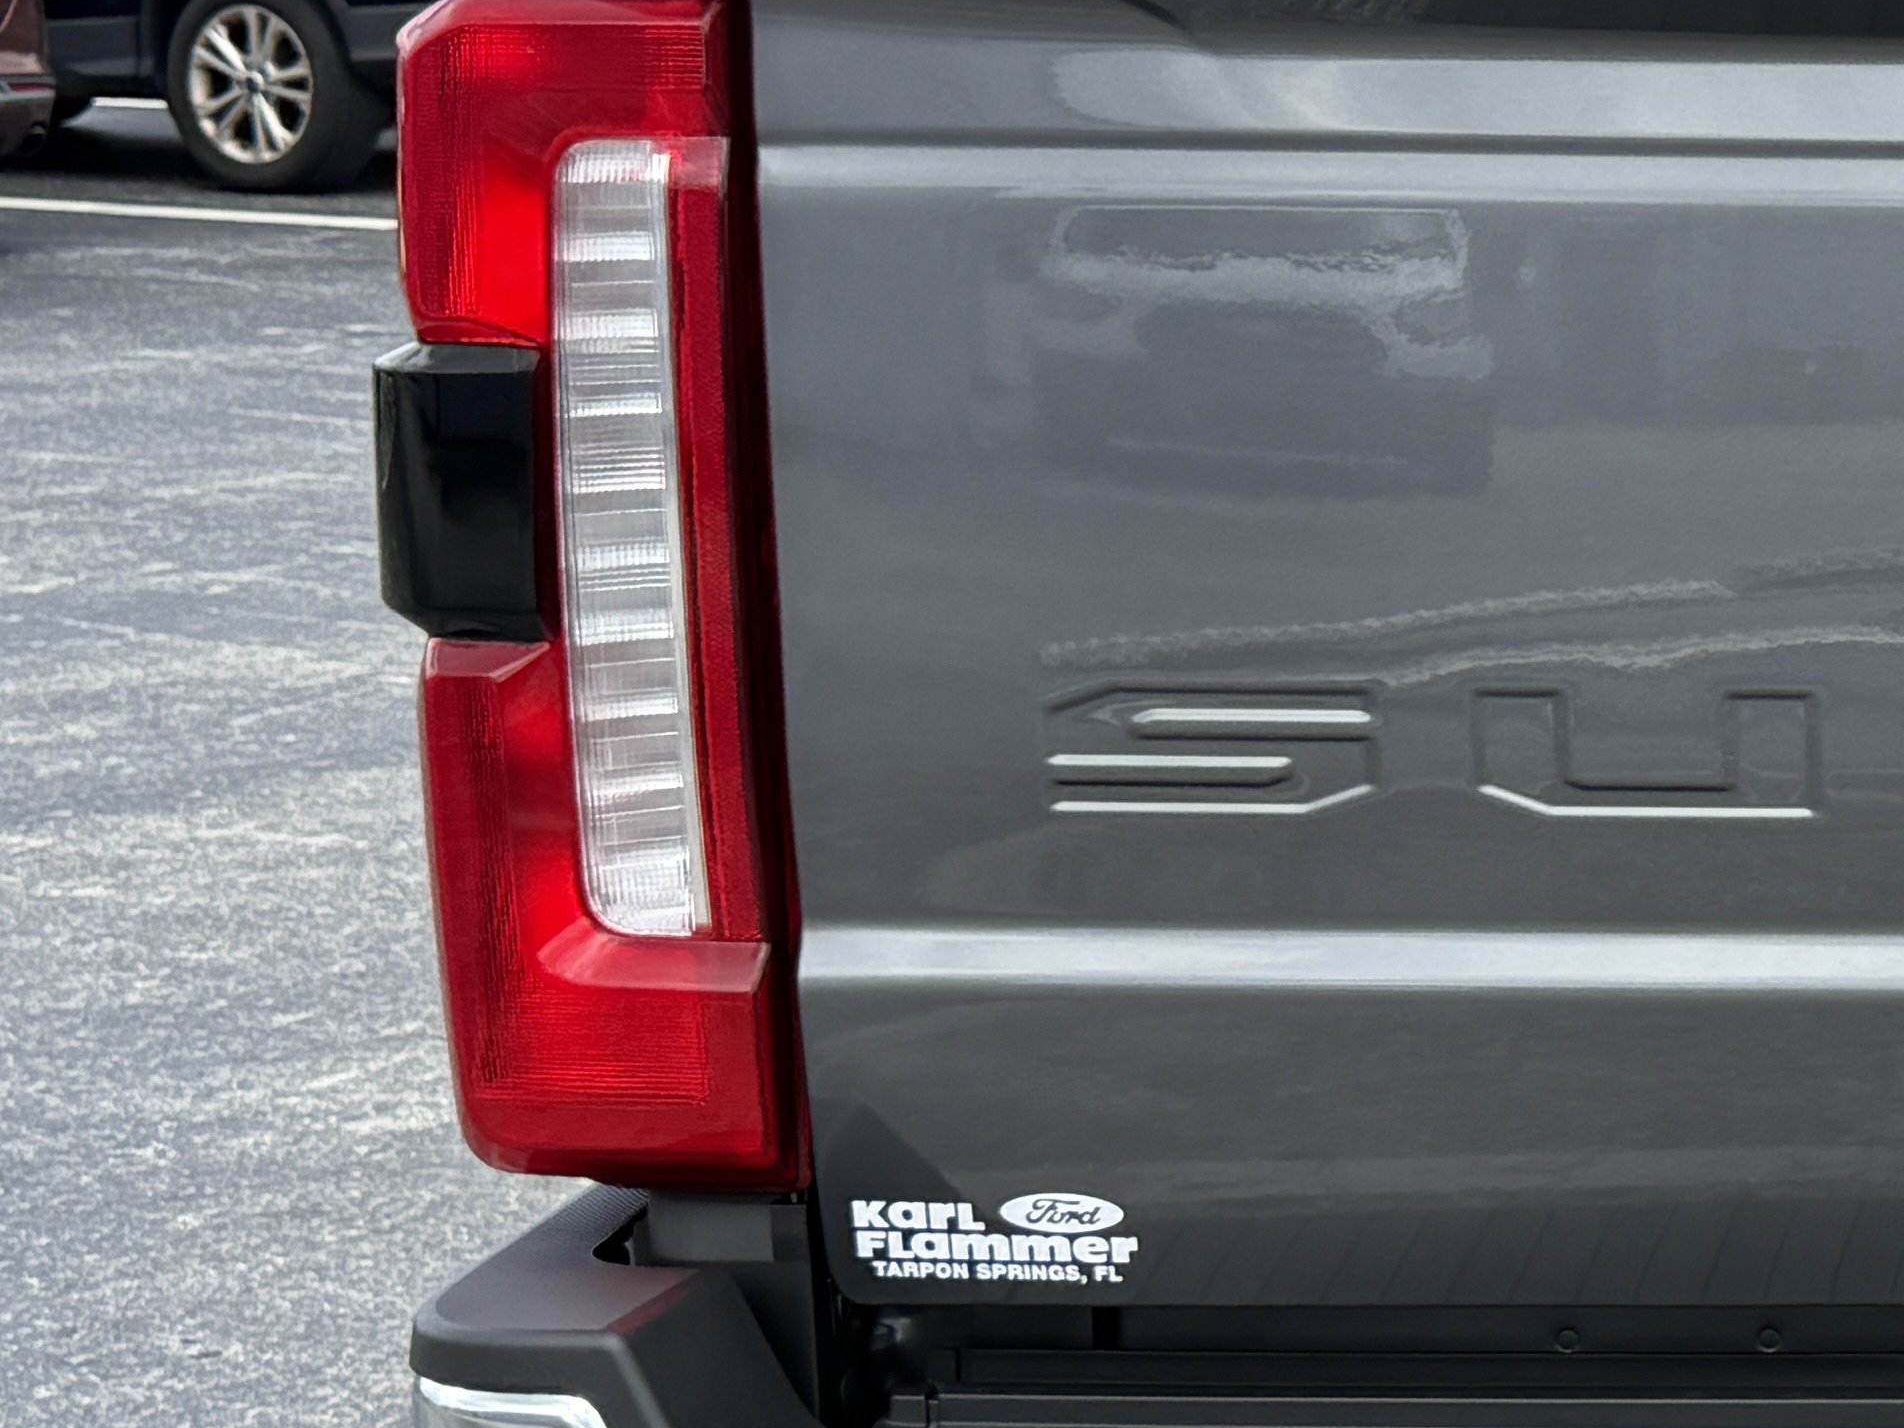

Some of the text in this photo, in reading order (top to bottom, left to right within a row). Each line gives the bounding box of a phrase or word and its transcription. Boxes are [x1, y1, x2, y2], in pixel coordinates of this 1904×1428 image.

[1025, 1198, 1102, 1225] Ford
[872, 1260, 1124, 1284] TARPON SPRINGS, FL
